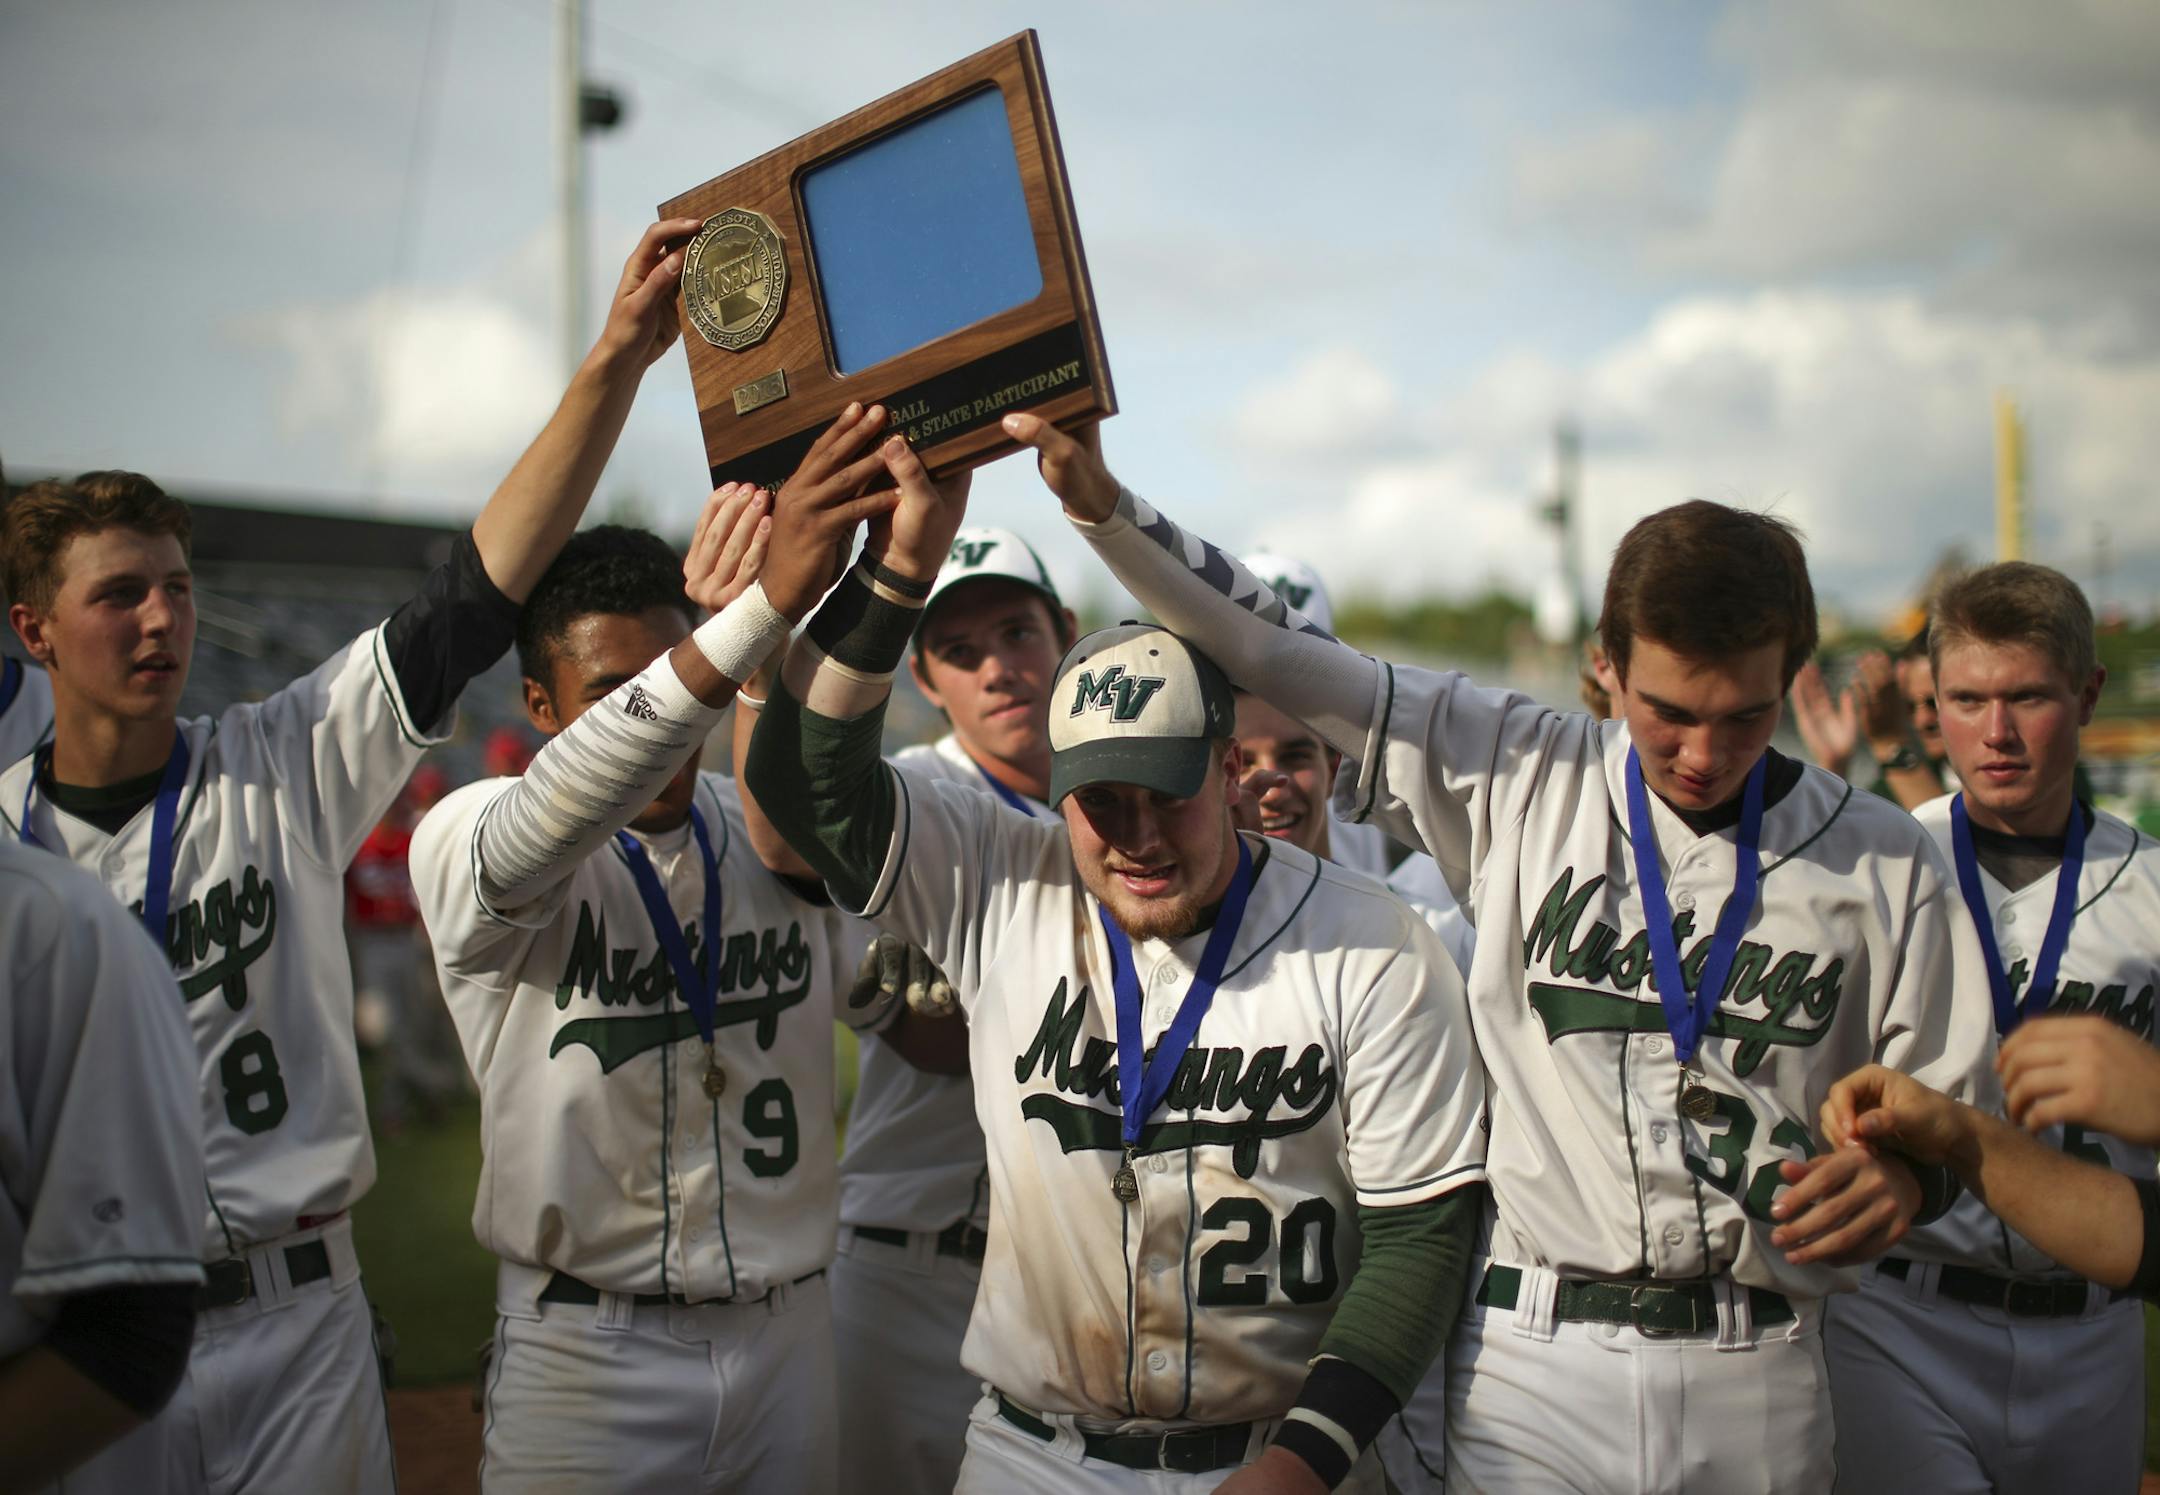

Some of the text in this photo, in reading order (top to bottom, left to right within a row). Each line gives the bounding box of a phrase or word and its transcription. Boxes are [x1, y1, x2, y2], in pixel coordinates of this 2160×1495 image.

[690, 213, 759, 257] MINNESOTA
[703, 253, 763, 304] MSHSL
[686, 291, 706, 331] STATE
[734, 310, 774, 345] SCHOOL
[769, 249, 783, 309] LEAGUE
[908, 361, 1080, 443] & STATE PARTICIPANT
[634, 683, 658, 721] adidas
[1070, 664, 1166, 723] MV
[220, 1029, 289, 1136] 8
[1014, 976, 1337, 1179] Musangs
[742, 1078, 799, 1177] 9
[1197, 1196, 1339, 1306] 20
